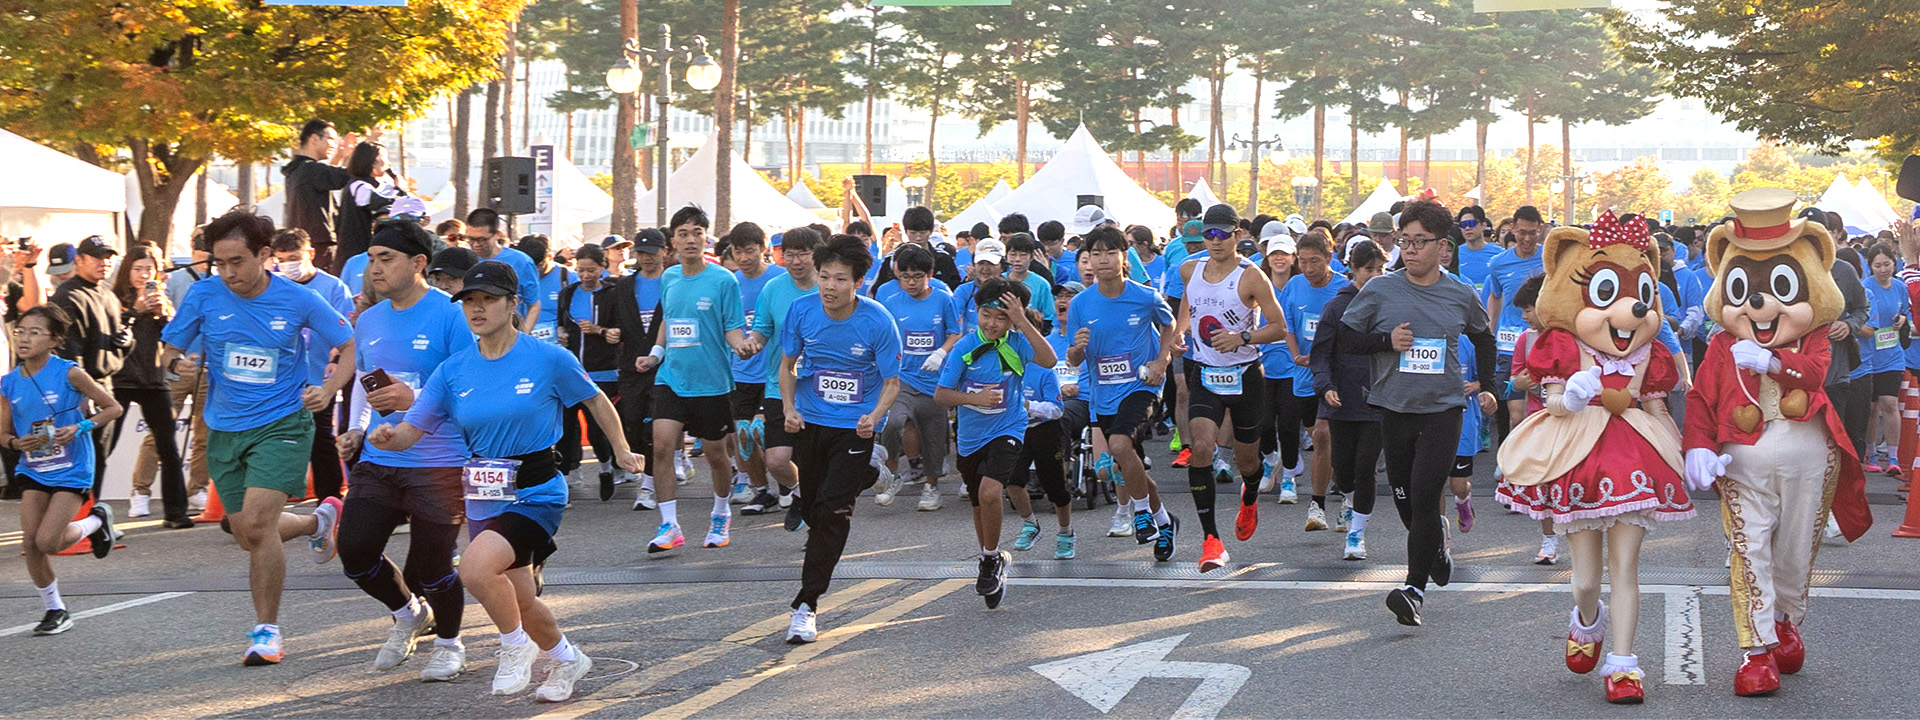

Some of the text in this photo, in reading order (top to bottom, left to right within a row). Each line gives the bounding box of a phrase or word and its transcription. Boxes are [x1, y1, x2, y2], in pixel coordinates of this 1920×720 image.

[536, 149, 549, 167] E
[1662, 211, 1670, 219] F
[672, 326, 692, 336] 1160
[909, 338, 932, 346] 3059
[1500, 333, 1516, 342] 1151
[1409, 349, 1438, 360] 1100
[234, 355, 267, 369] 1147
[1101, 363, 1127, 374] 3120
[822, 378, 856, 392] 3092
[1209, 375, 1234, 384] 1110
[473, 471, 504, 484] 4154
